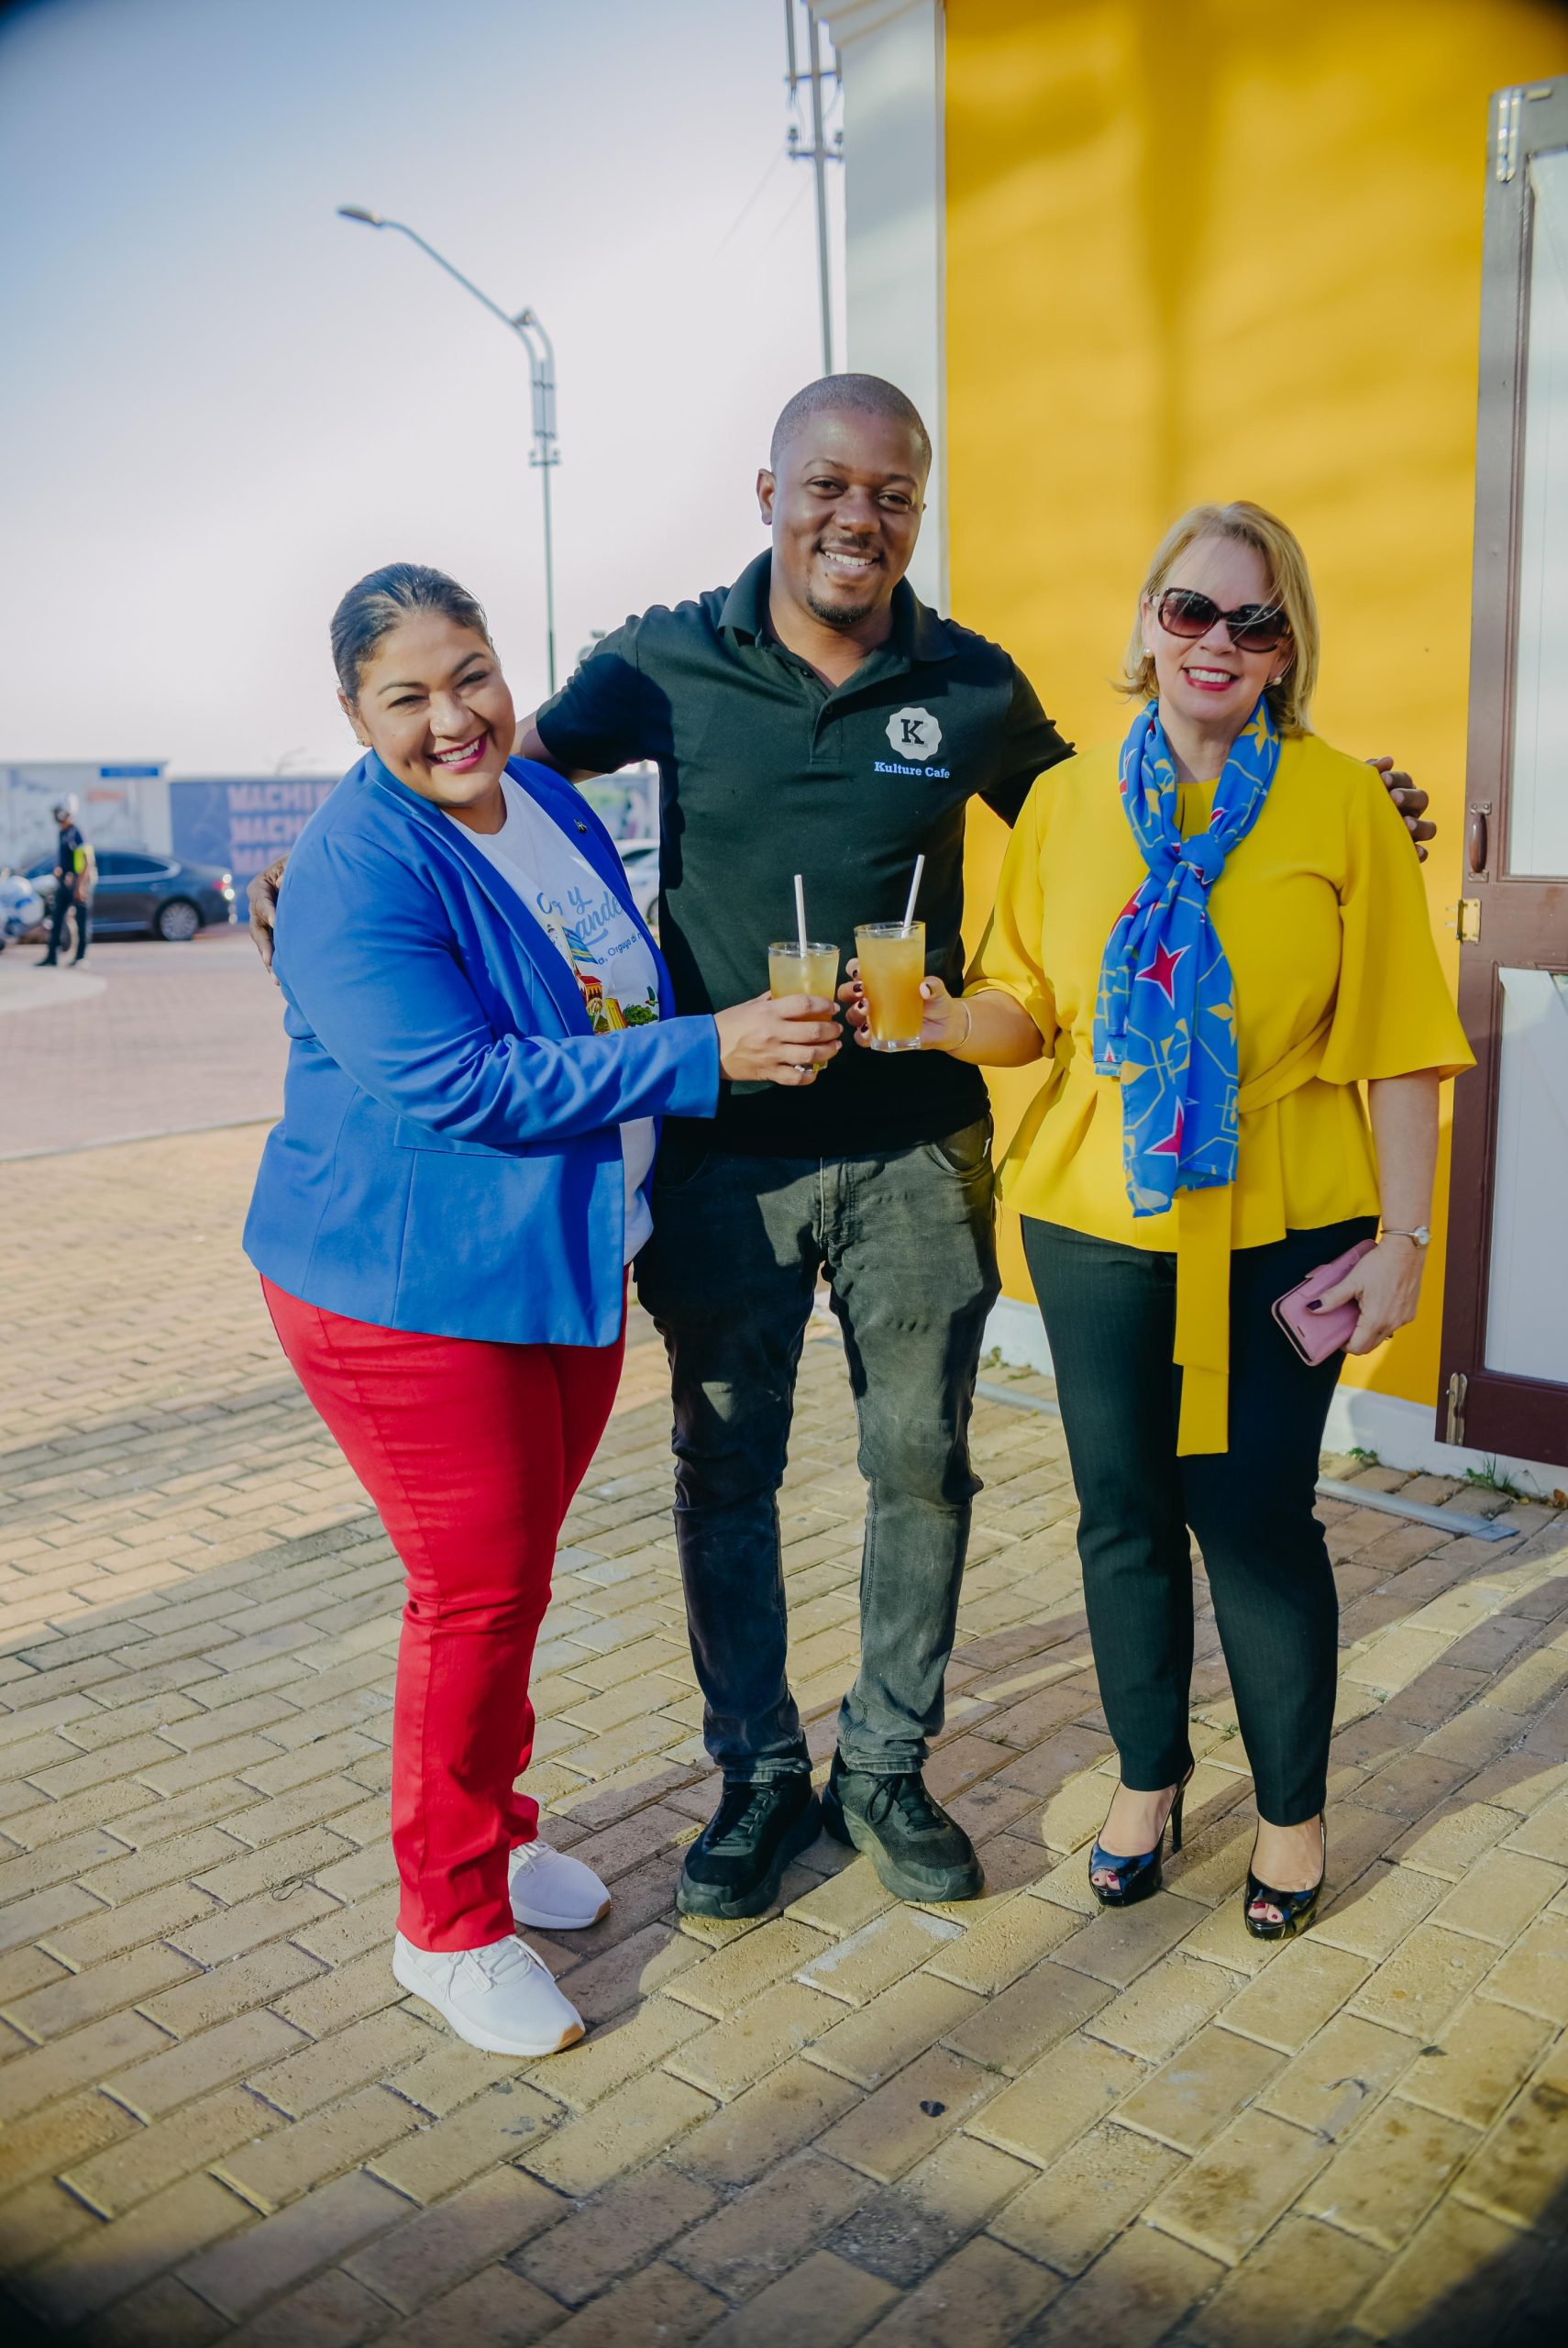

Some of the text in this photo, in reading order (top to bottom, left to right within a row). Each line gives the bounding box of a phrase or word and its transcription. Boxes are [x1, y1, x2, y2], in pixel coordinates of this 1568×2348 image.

[900, 718, 924, 745] K
[874, 761, 951, 779] Kulture Cafe
[575, 891, 624, 940] ande
